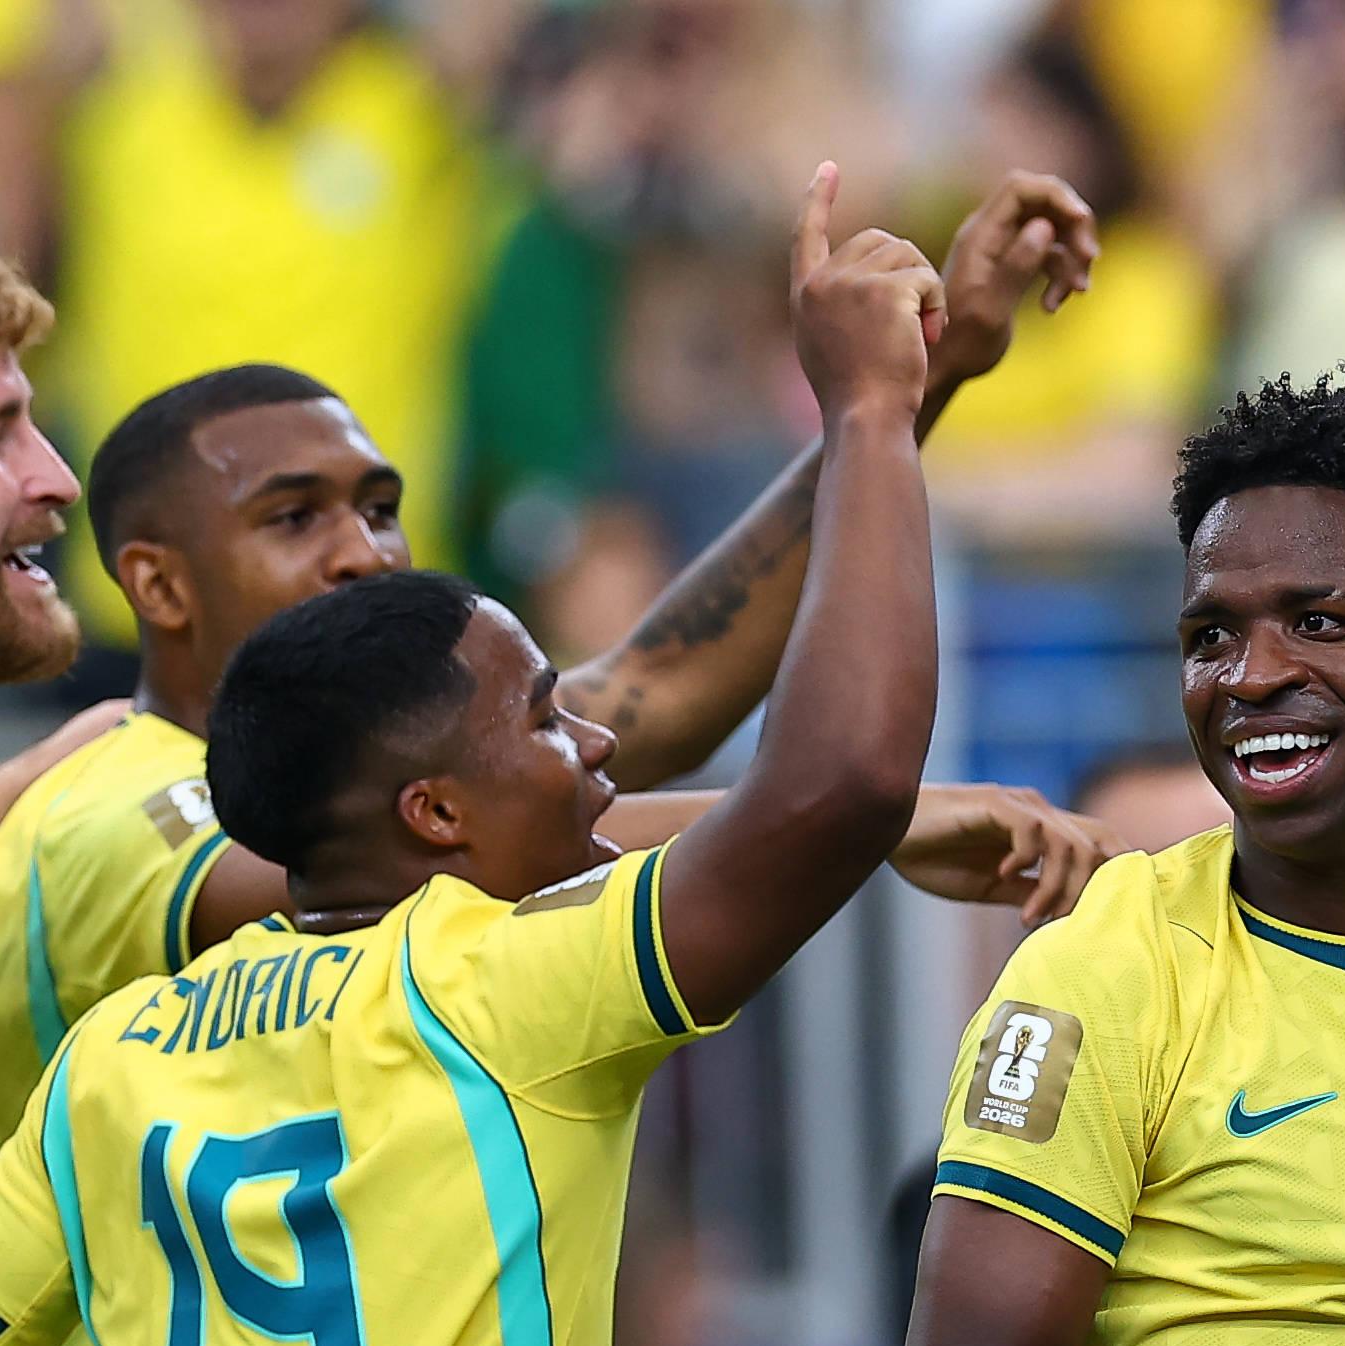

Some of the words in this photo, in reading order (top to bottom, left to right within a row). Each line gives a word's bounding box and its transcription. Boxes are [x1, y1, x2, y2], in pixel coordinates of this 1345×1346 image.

[998, 1079, 1020, 1092] FIFA
[983, 1096, 1010, 1110] WORLD
[1009, 1103, 1030, 1115] CUP
[978, 1106, 1027, 1129] 2026
